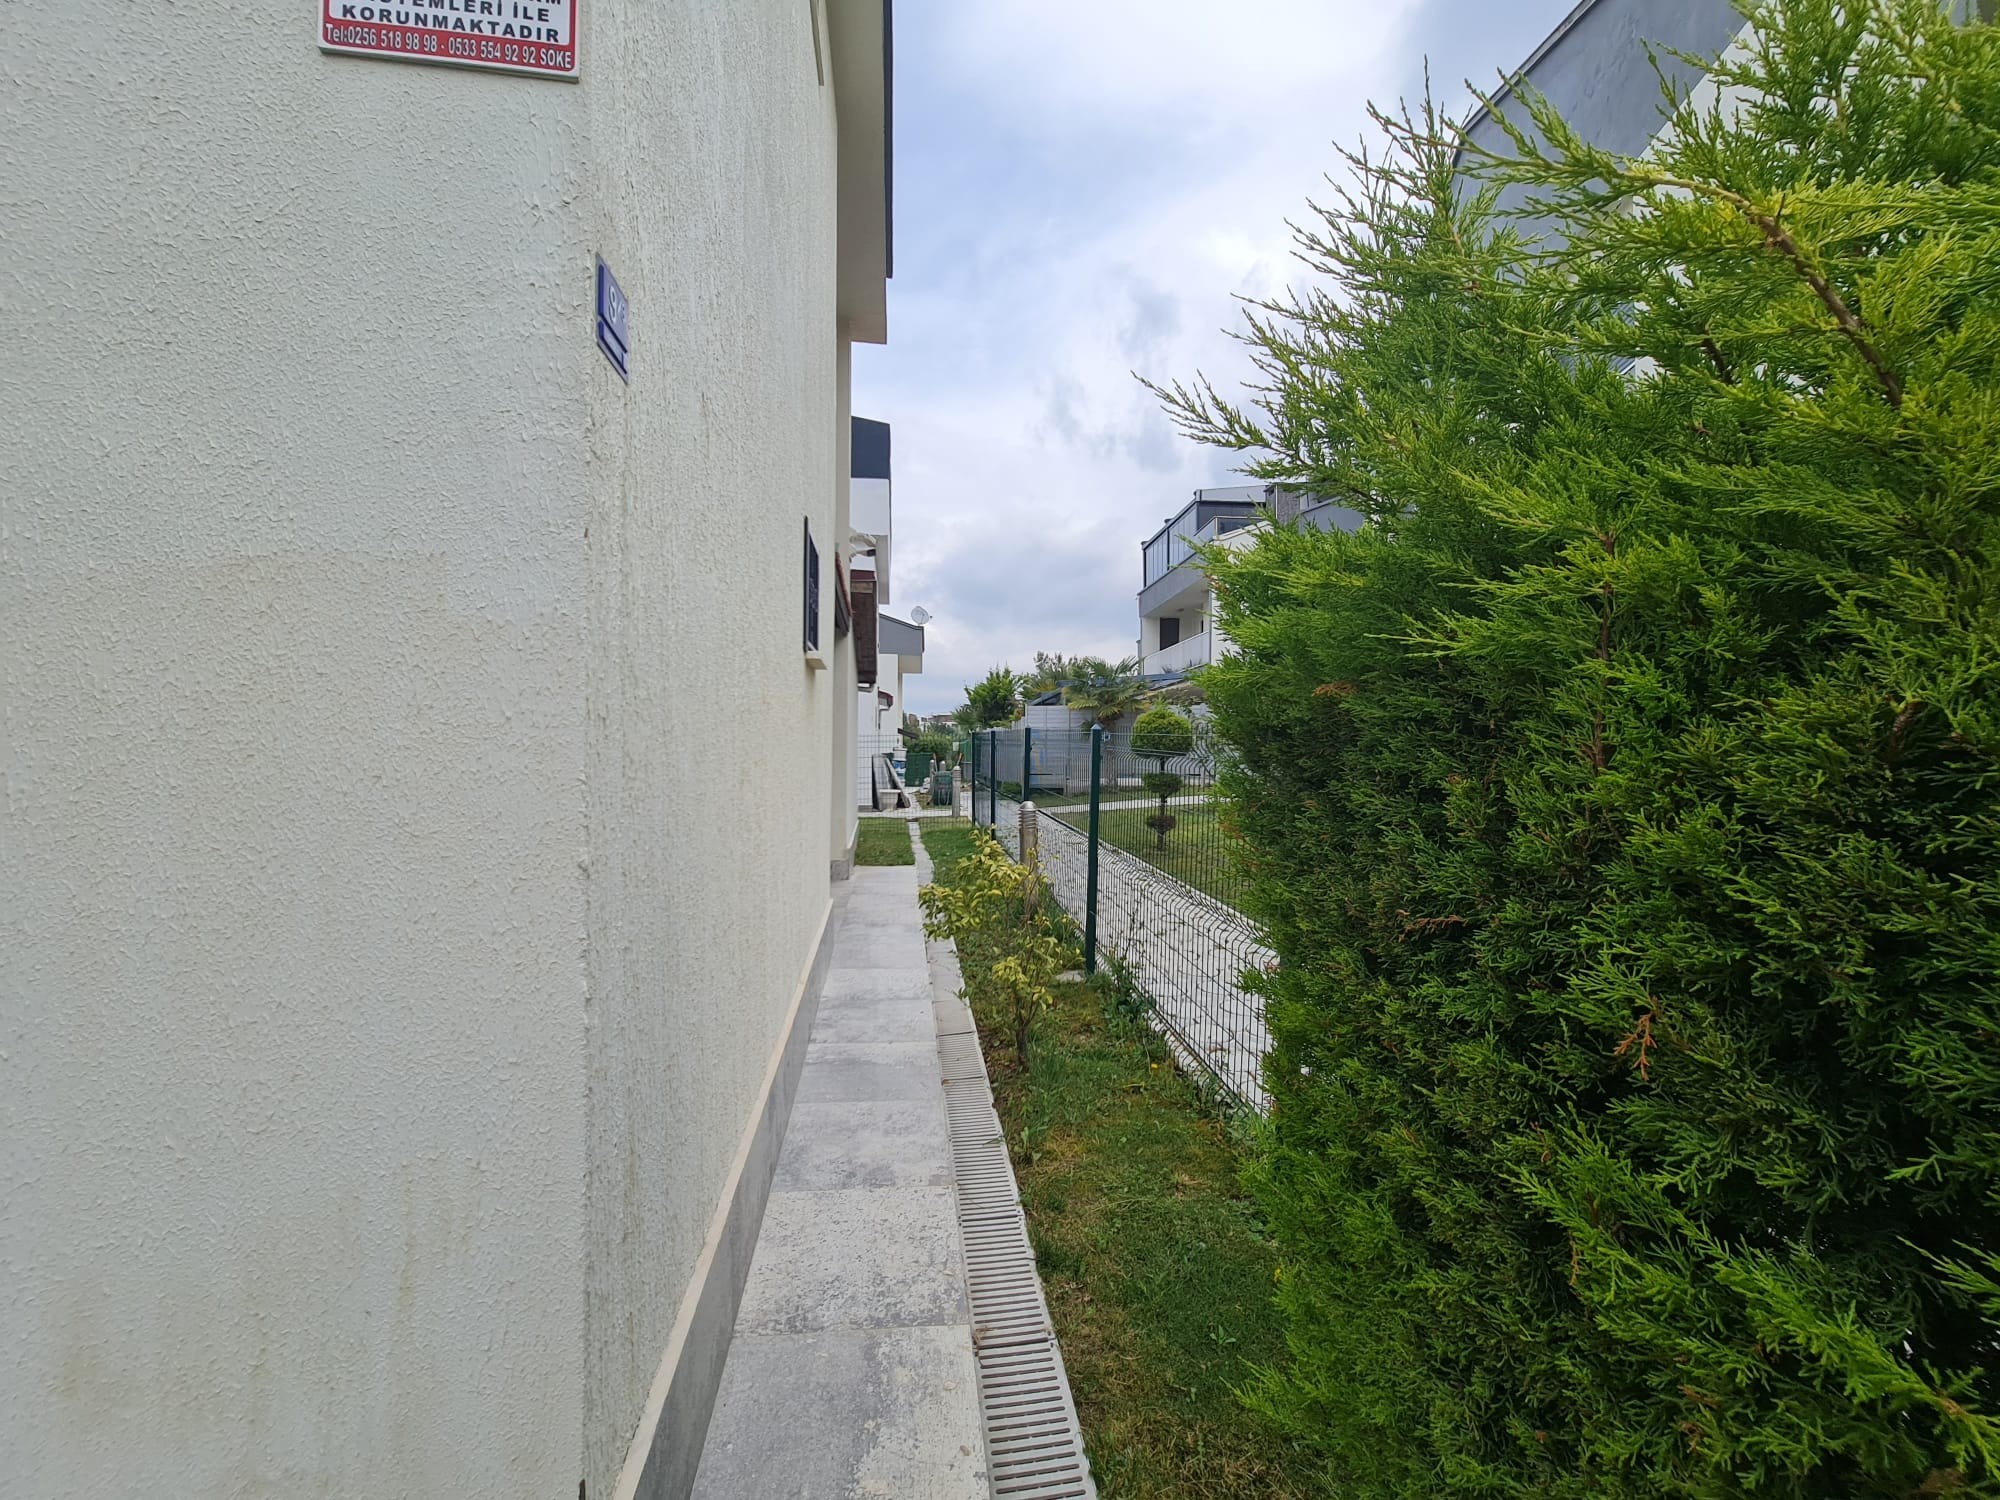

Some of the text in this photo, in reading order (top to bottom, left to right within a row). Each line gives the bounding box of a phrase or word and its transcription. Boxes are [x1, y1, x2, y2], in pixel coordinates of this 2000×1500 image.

[341, 4, 559, 43] KORUNMAKTADIR
[513, 2, 550, 22] İLE
[325, 23, 377, 46] Tel:0256
[380, 30, 402, 48] 518
[405, 32, 420, 50] 98
[423, 35, 438, 53] 98
[448, 37, 477, 57] 0533
[480, 41, 501, 59] 554
[504, 44, 519, 62] 92
[522, 46, 537, 64] 92
